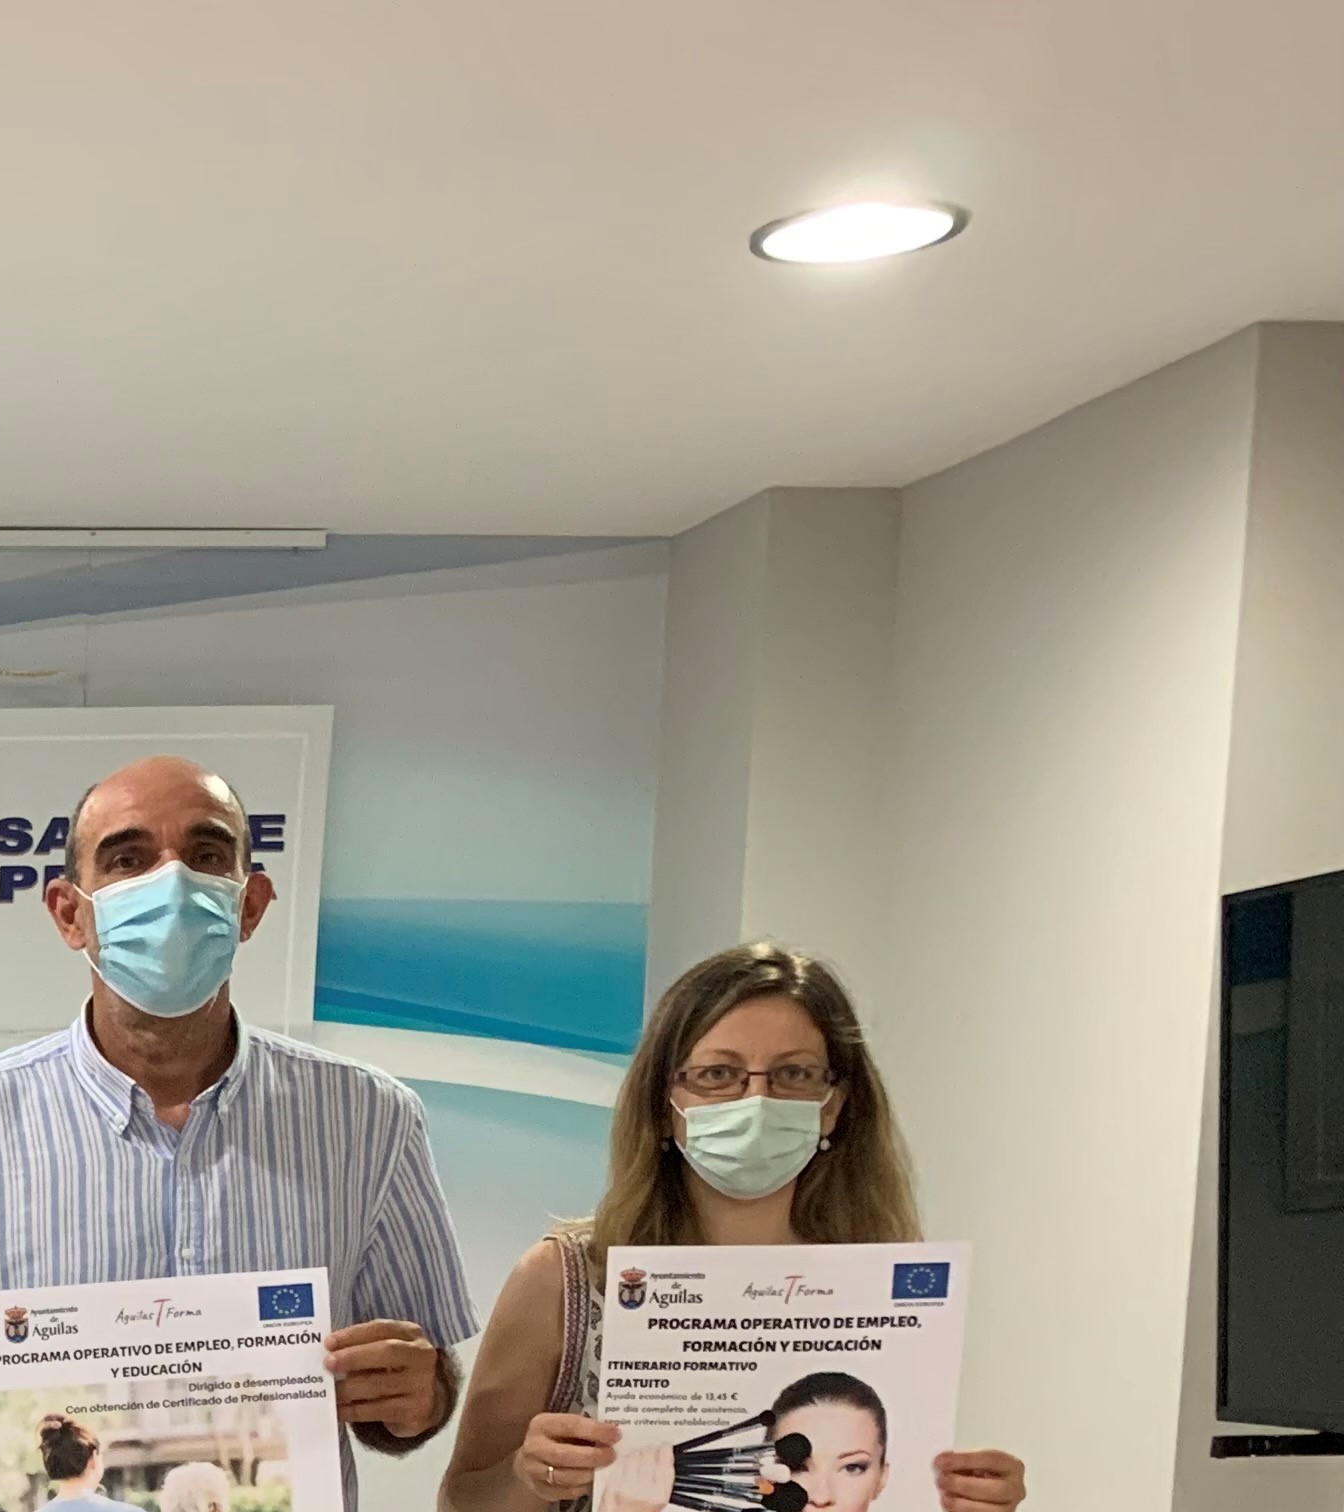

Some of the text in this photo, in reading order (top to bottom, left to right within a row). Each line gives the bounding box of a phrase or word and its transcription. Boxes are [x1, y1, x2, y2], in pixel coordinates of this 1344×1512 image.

[649, 1289, 703, 1308] Águilas
[32, 1321, 78, 1340] Águilas
[647, 1317, 737, 1329] PROGRAMA
[740, 1317, 831, 1329] OPERATIVO
[833, 1316, 854, 1329] DE
[72, 1344, 152, 1360] OPERATIVO
[154, 1342, 173, 1354] DE
[236, 1330, 321, 1348] FORMACIÓN
[682, 1336, 882, 1352] FORMACIÓN Y EDUCACIÓN
[110, 1359, 202, 1378] Y EDUCACIÓN
